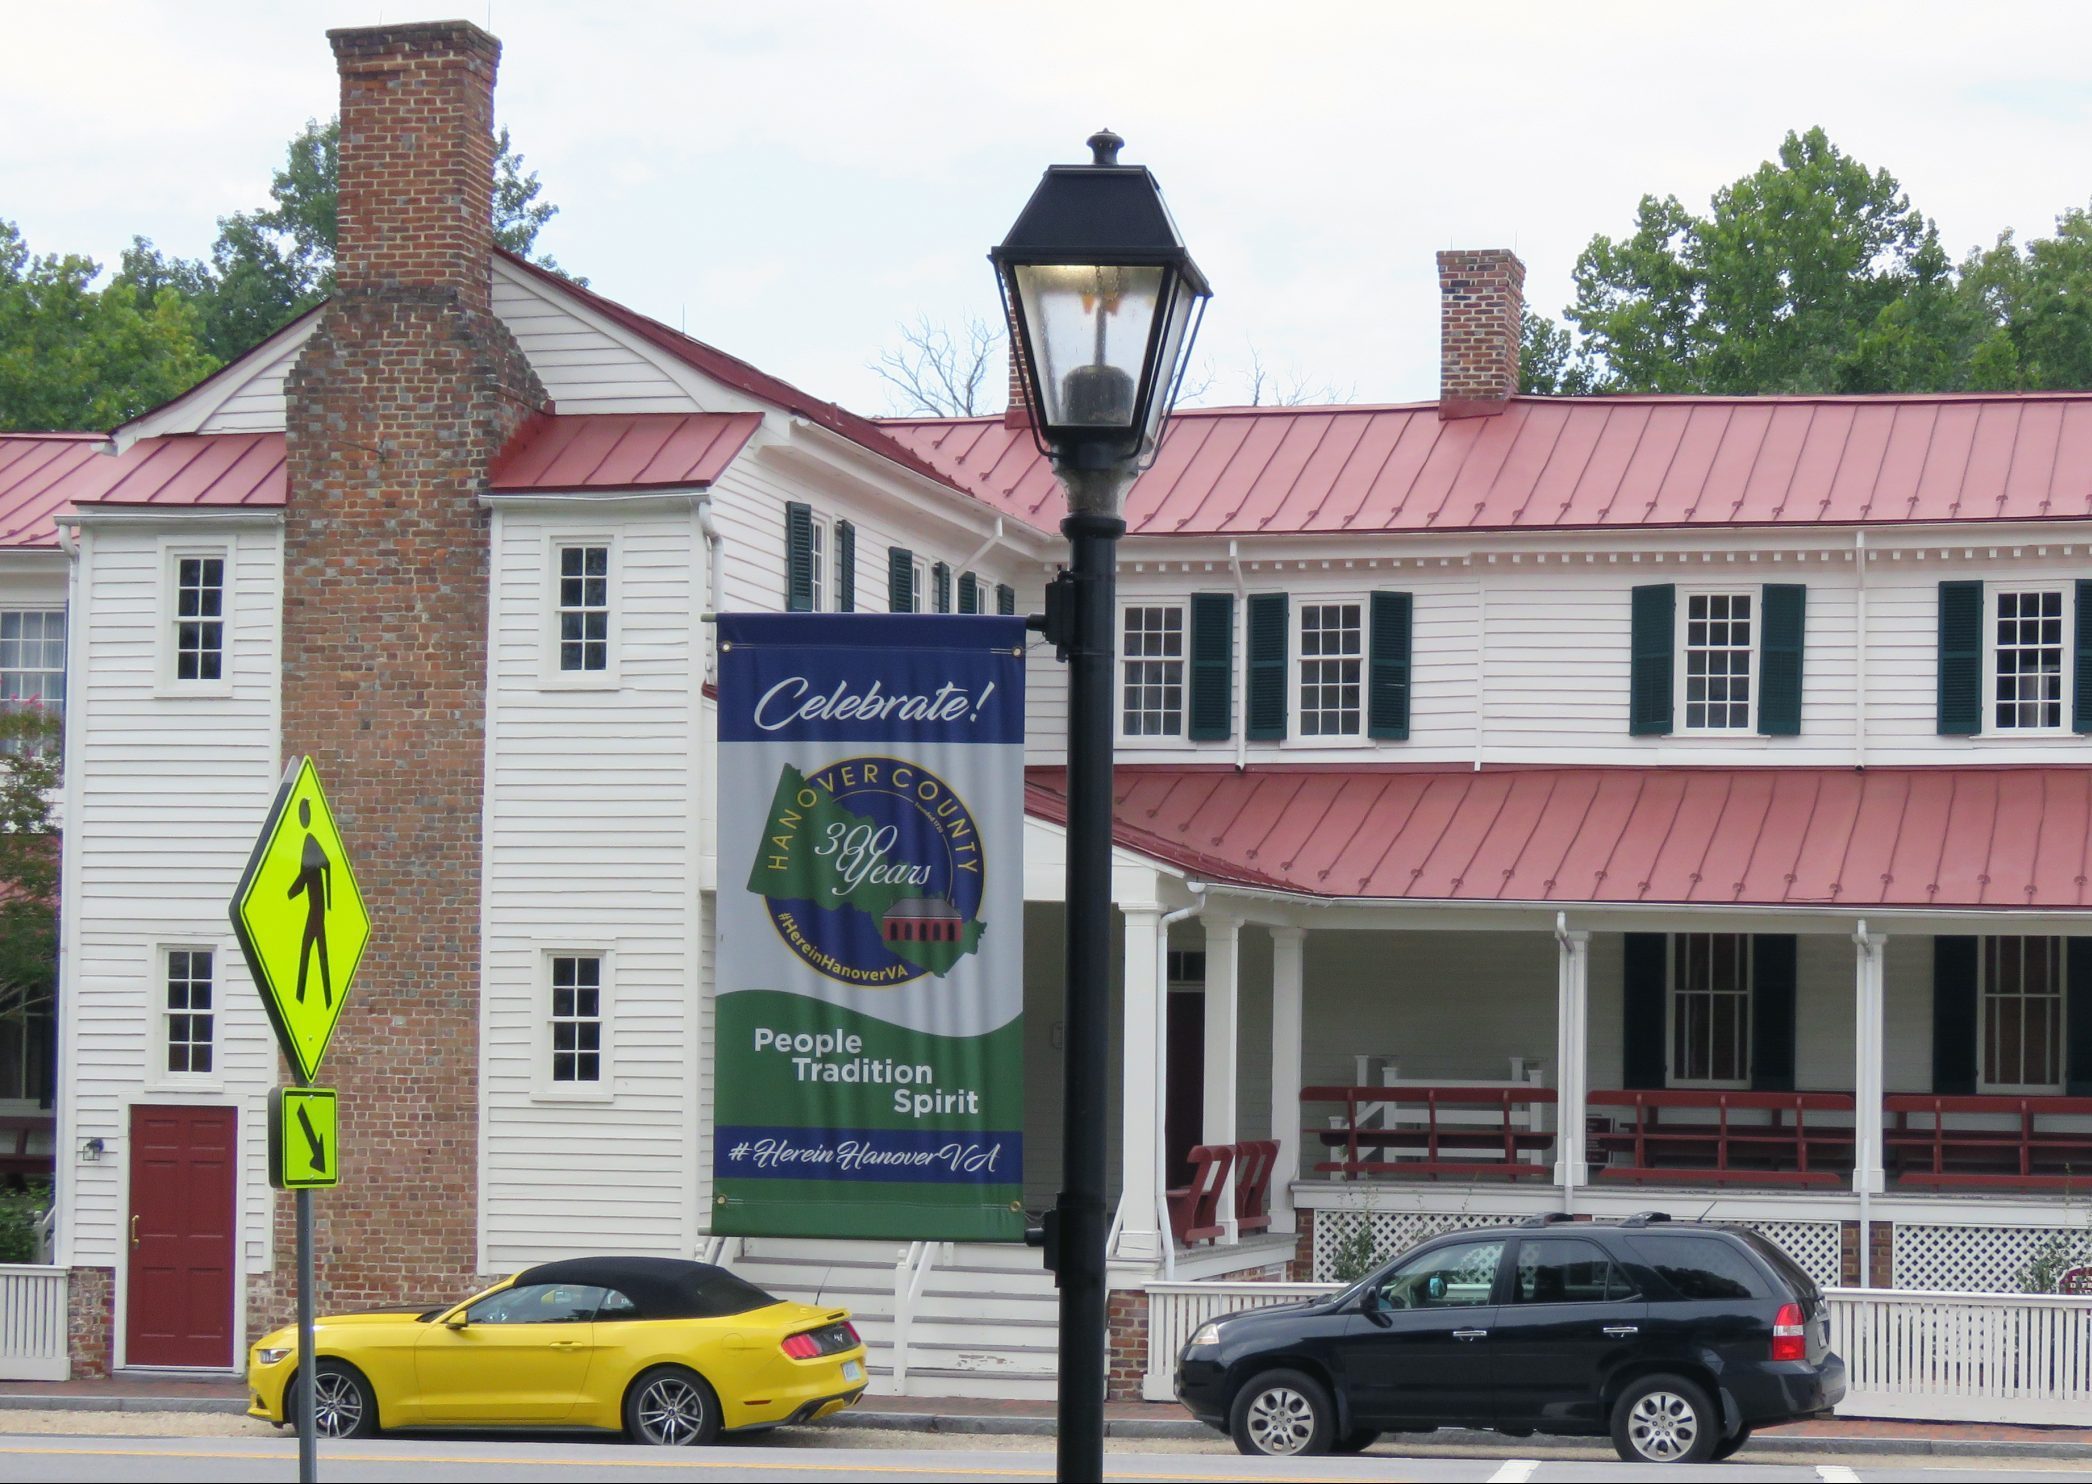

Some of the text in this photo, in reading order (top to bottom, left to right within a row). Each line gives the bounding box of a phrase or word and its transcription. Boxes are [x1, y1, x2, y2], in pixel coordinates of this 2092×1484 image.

[754, 676, 995, 730] Celebrate!
[768, 764, 977, 873] HANOVER COUNTY
[814, 822, 898, 855] 300
[831, 847, 932, 895] Years
[778, 912, 908, 981] #HereinHanoverVA
[754, 1028, 862, 1057] People
[792, 1057, 932, 1084] Tradition
[894, 1089, 978, 1118] Spirit
